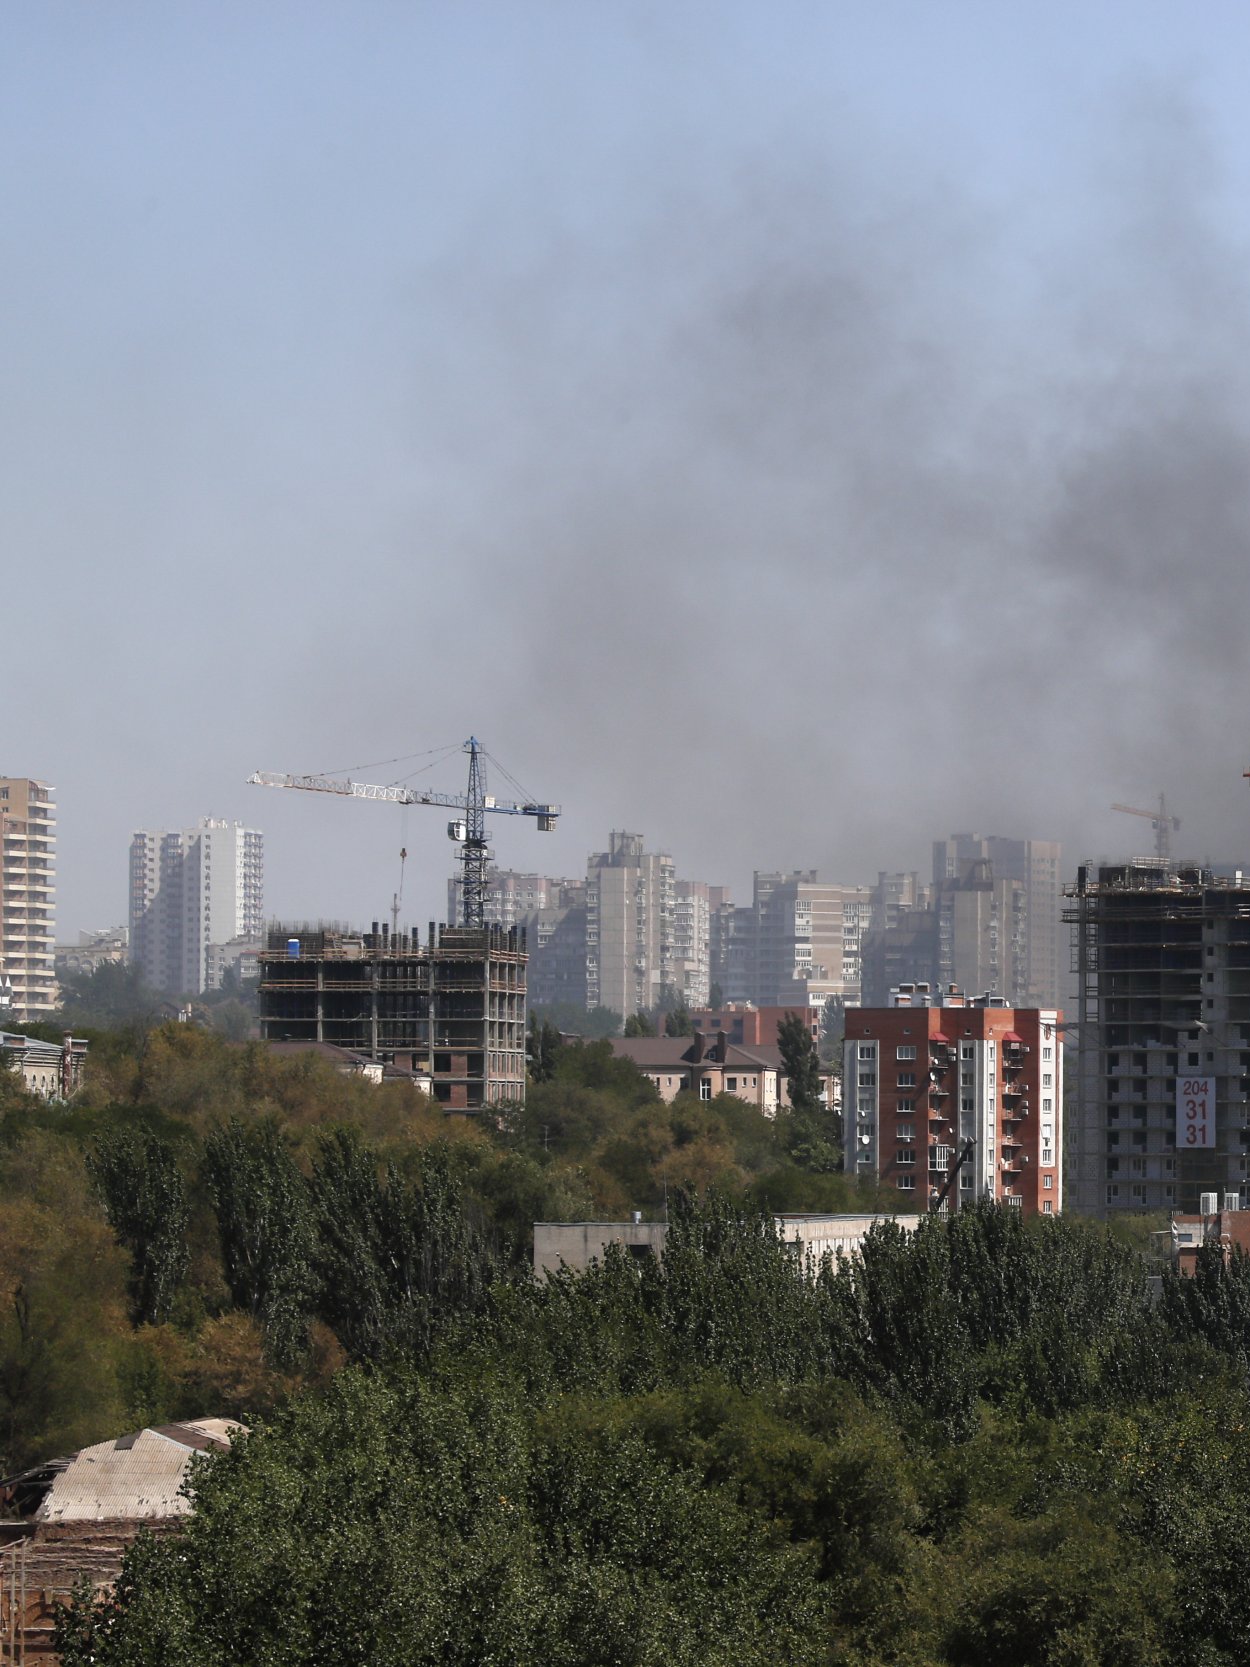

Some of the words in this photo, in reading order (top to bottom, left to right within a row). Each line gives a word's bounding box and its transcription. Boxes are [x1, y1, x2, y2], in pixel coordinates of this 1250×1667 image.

[1183, 1080, 1208, 1096] 204
[1186, 1099, 1207, 1120] 31
[1186, 1124, 1207, 1145] 31
